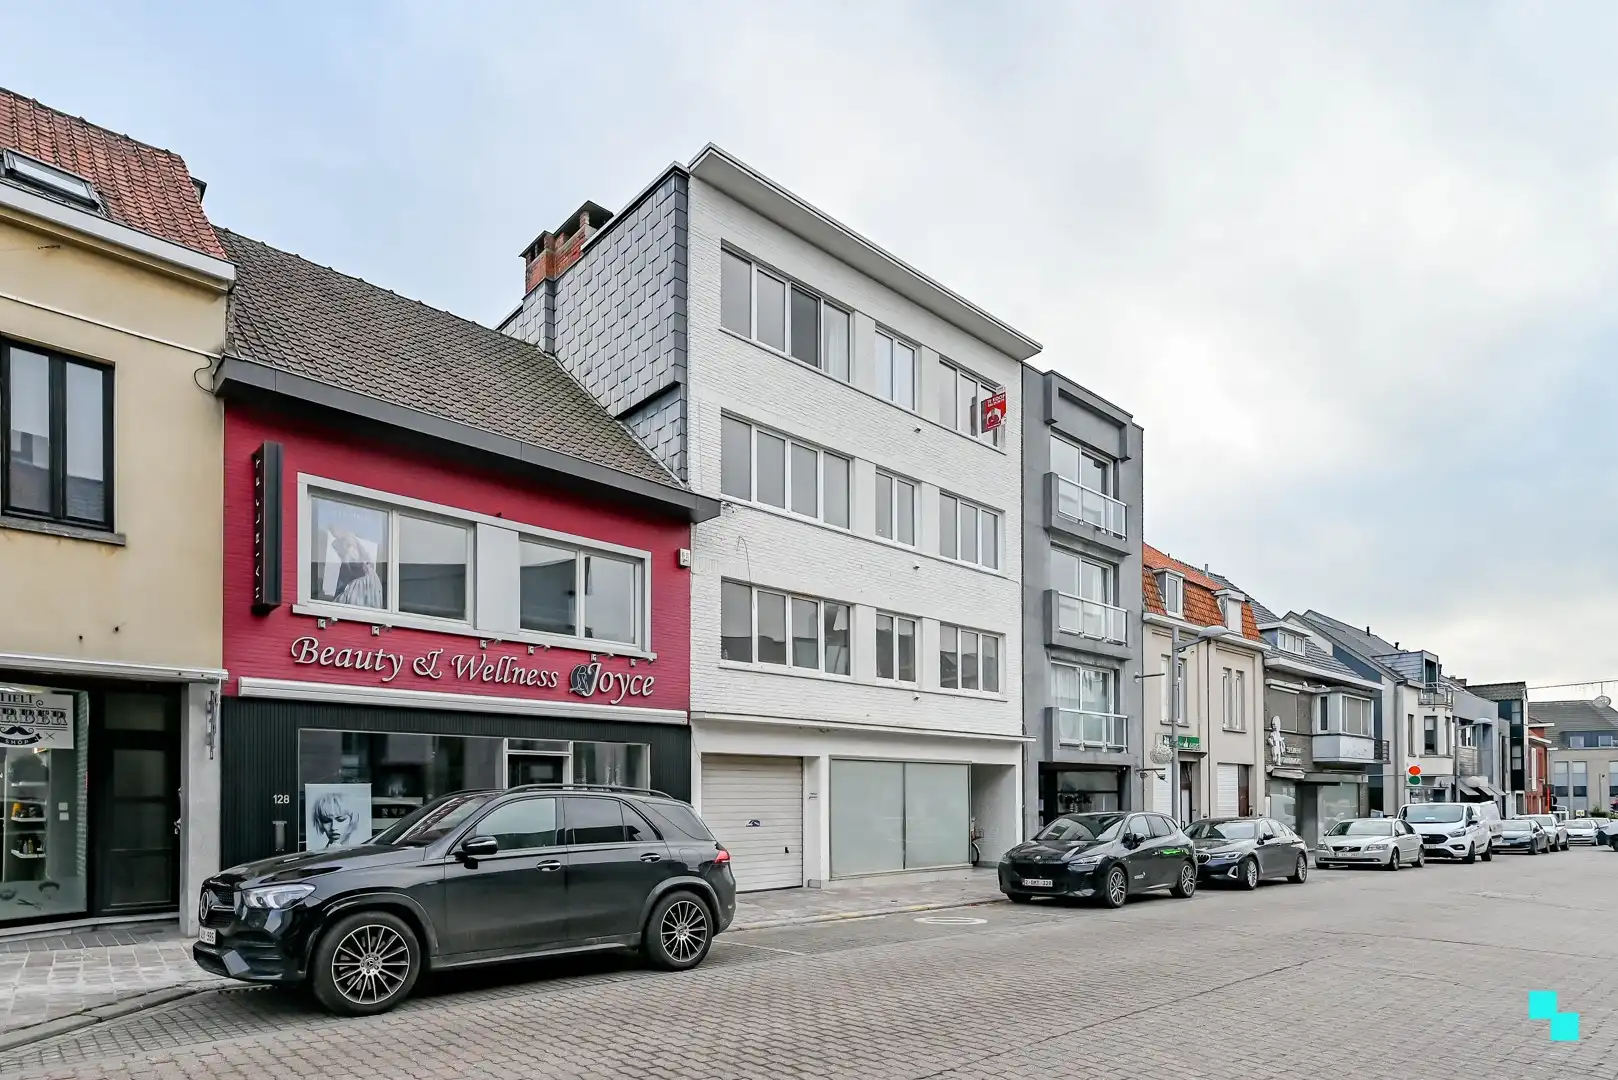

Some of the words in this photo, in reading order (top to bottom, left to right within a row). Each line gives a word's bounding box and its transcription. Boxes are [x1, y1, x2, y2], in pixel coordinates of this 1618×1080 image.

[290, 636, 403, 682] Beauty
[412, 648, 444, 680] &
[451, 653, 559, 688] Wellness
[582, 662, 655, 705] Joyce
[272, 794, 290, 804] 128
